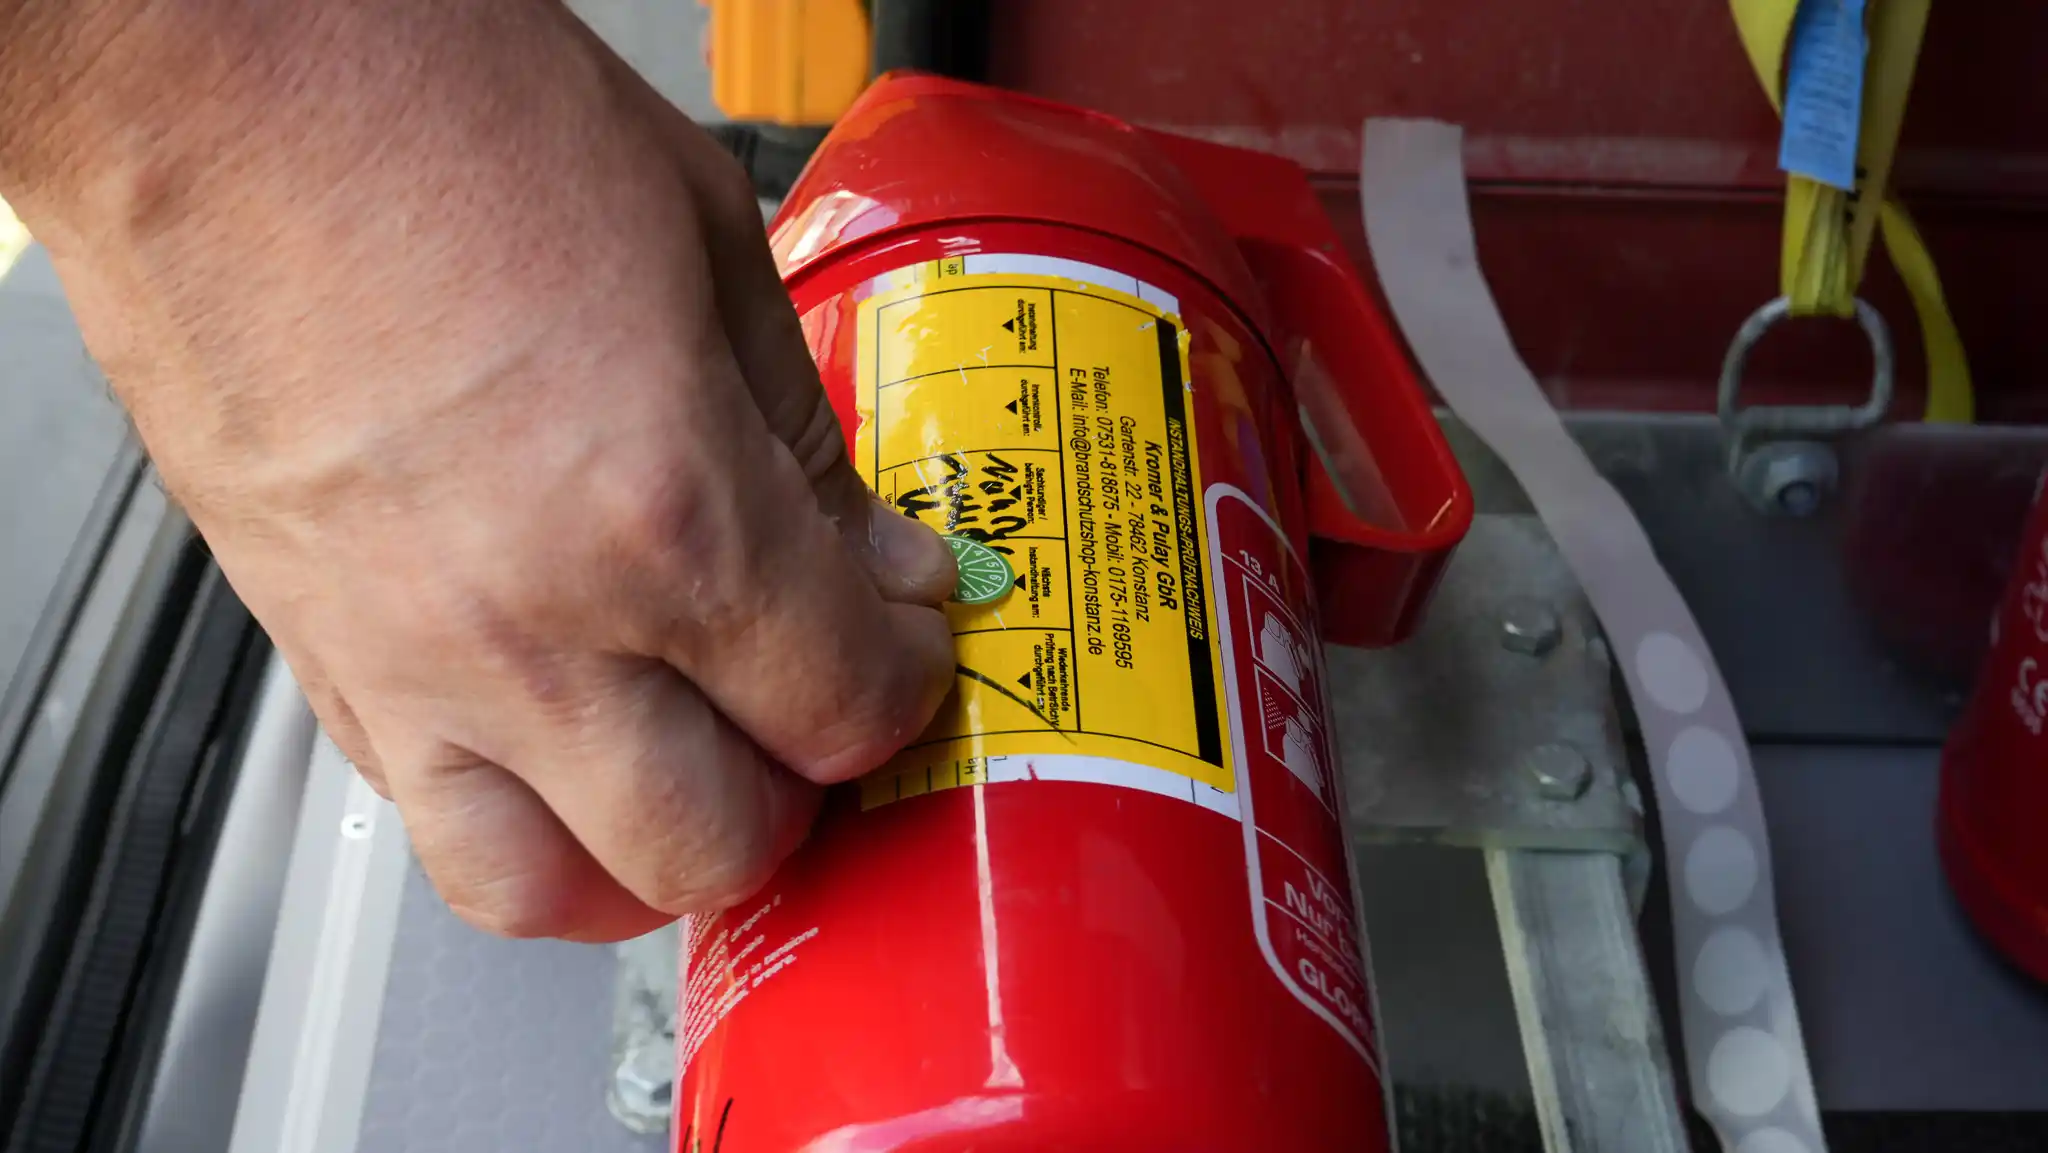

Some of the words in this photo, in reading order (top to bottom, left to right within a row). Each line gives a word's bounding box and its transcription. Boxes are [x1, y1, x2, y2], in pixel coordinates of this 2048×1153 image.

[1028, 303, 1037, 350] Instandhaltung
[1019, 379, 1030, 422] durchgeführt
[1070, 367, 1088, 411] E-Mail:
[1092, 366, 1111, 413] Telefon:
[1096, 416, 1120, 511] 07531-818675
[1119, 415, 1140, 477] Gartenstr.
[1023, 463, 1034, 494] befähigte
[1036, 467, 1046, 516] Sachkundiger
[1125, 480, 1143, 500] 22
[1144, 440, 1163, 502] Kromer
[1026, 496, 1035, 524] Person:
[1150, 503, 1169, 517] &
[951, 541, 961, 549] 3
[1070, 413, 1106, 655] info@brandschutzshop-konstanz.de
[1104, 521, 1125, 563] Mobil:
[1128, 512, 1148, 555] 78462
[1151, 520, 1172, 568] Pulay
[961, 590, 972, 598] 8
[981, 585, 994, 593] 7
[1029, 547, 1039, 601] Instandhaltung
[1041, 567, 1051, 597] Nächste
[1132, 556, 1151, 623] Konstanz
[1156, 571, 1178, 610] GbR
[1238, 549, 1263, 577] 13
[1268, 572, 1281, 595] A
[1108, 566, 1133, 669] 0175-1169595
[1033, 644, 1046, 695] durchgeführt
[1044, 633, 1055, 663] Prüfung
[1047, 665, 1057, 684] nach
[1058, 648, 1070, 711] Wiederkehrende
[1284, 880, 1334, 938] Nur
